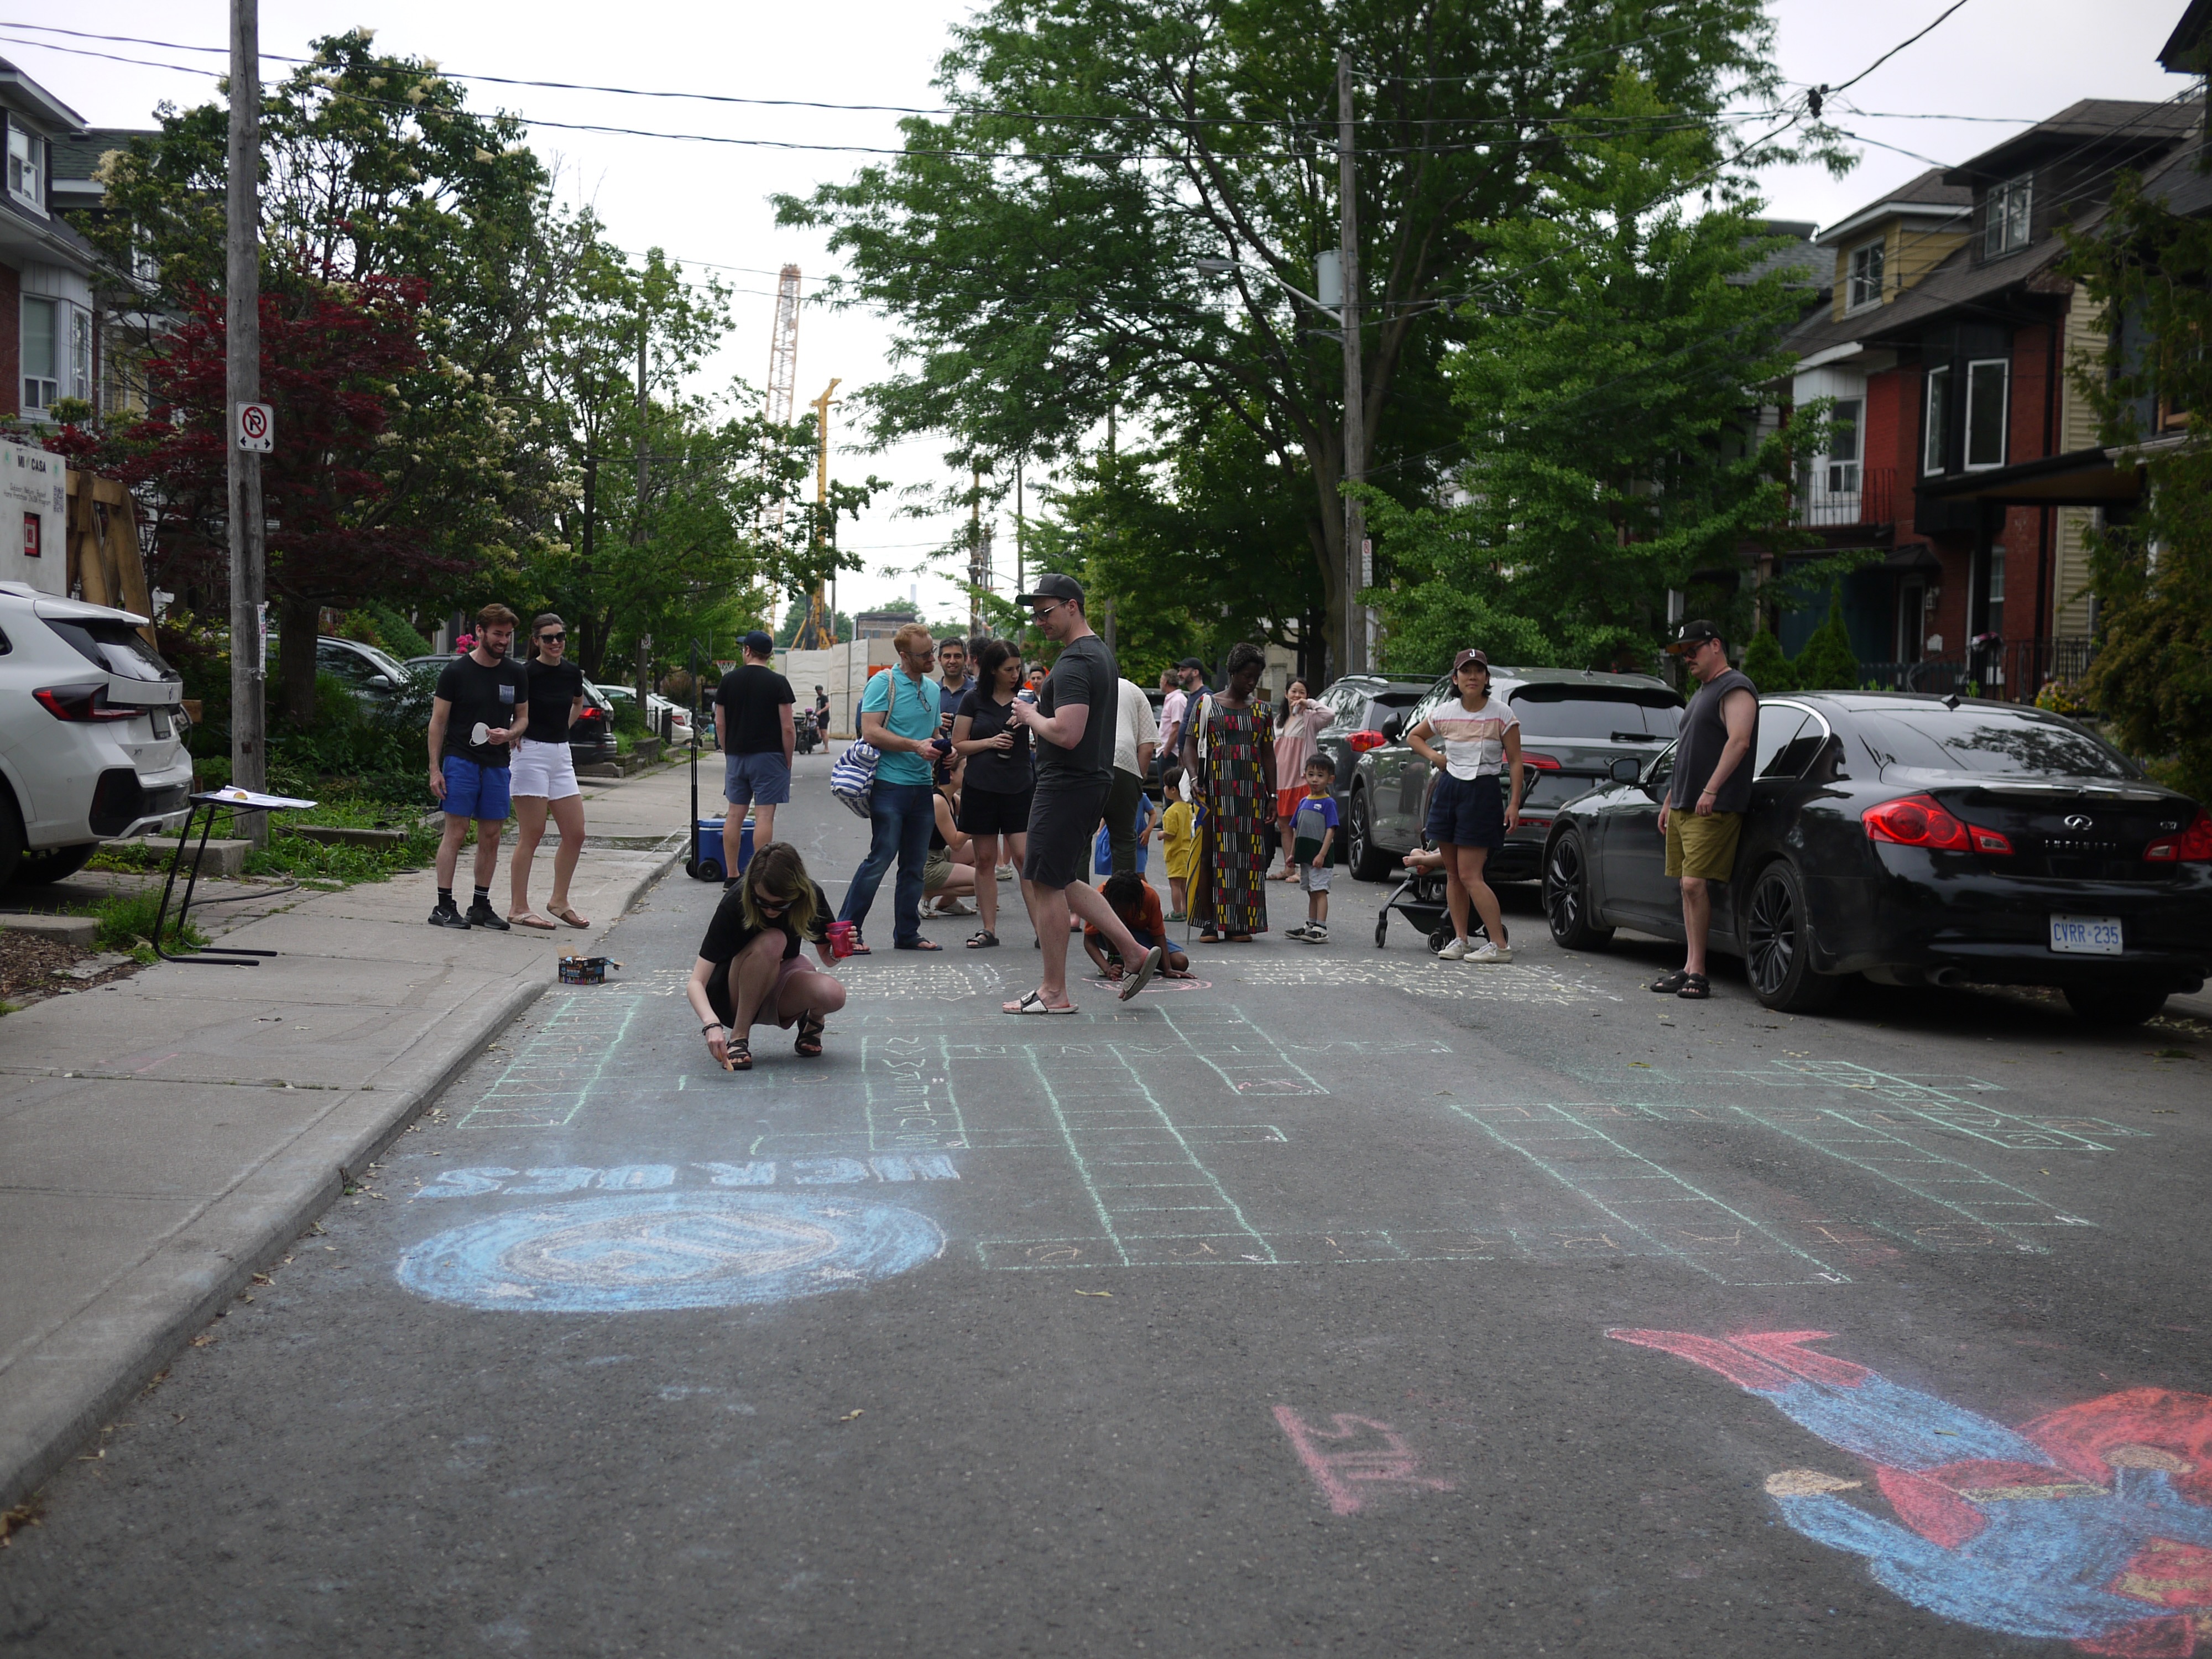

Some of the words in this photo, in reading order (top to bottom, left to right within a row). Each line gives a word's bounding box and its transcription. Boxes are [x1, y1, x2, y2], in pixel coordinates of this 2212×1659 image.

[18, 455, 25, 468] MI
[32, 458, 46, 473] CASA
[1469, 649, 1475, 657] J
[2054, 922, 2086, 942] CVRR
[2094, 925, 2119, 945] 235
